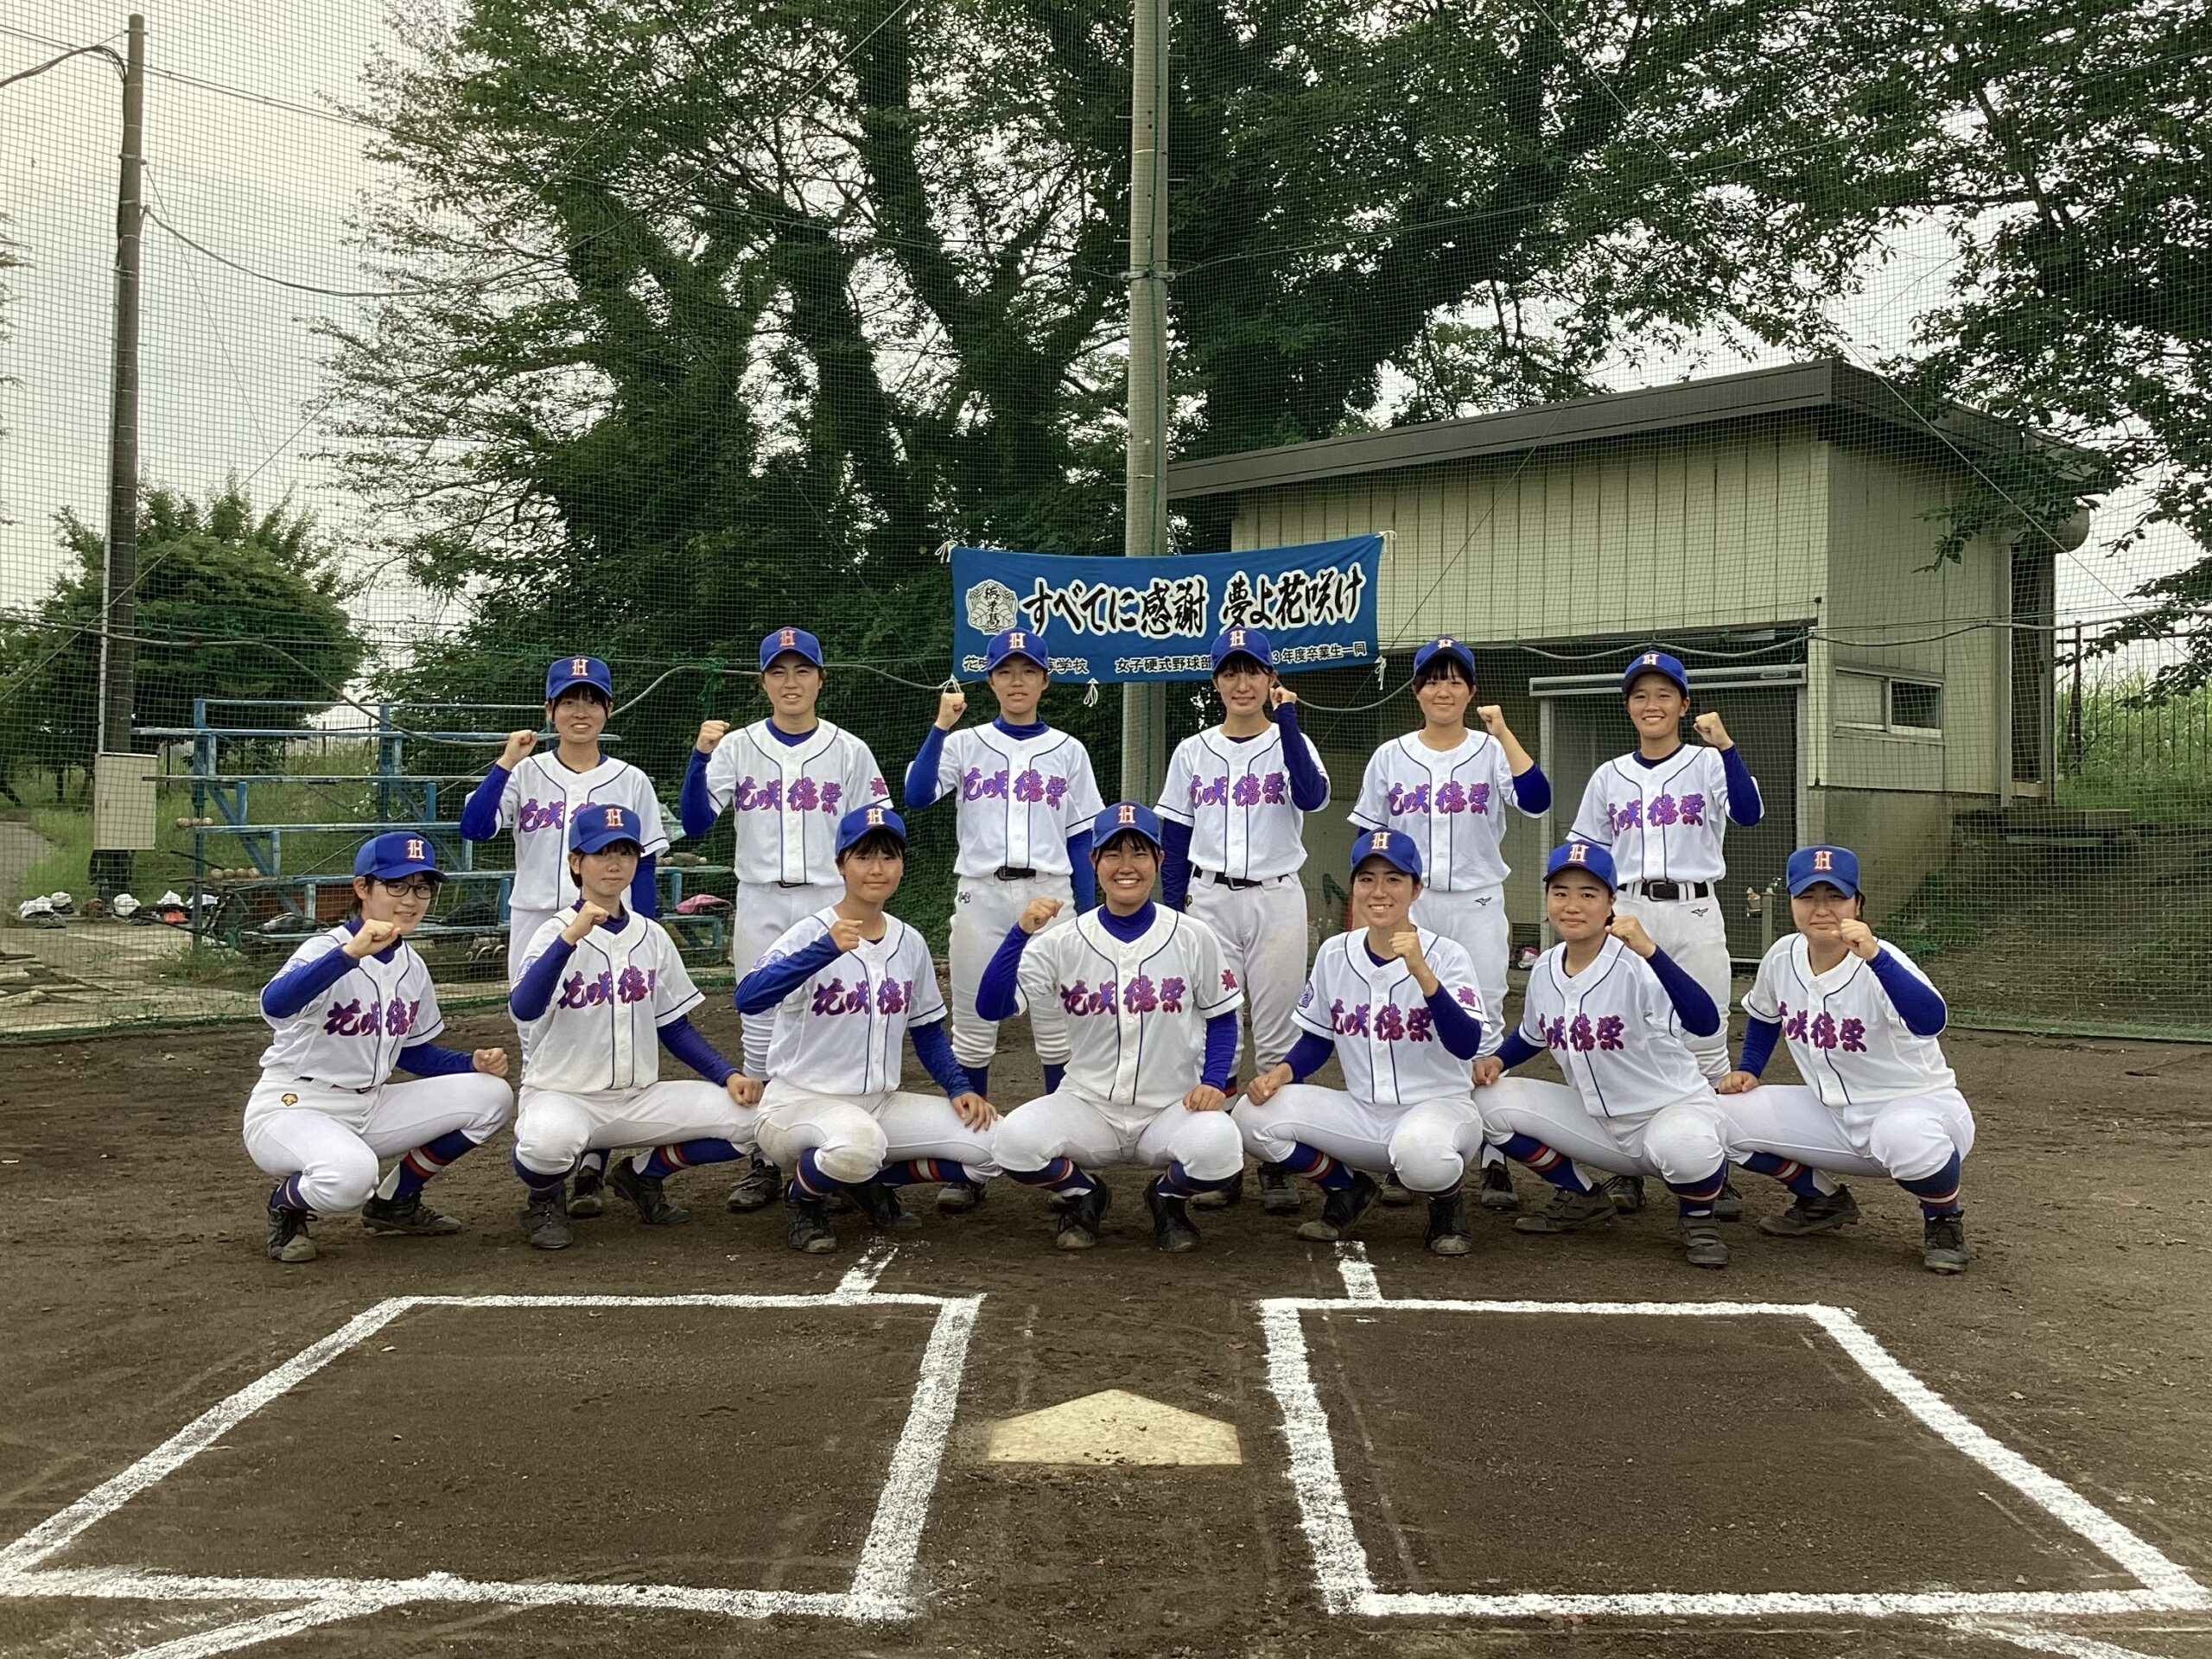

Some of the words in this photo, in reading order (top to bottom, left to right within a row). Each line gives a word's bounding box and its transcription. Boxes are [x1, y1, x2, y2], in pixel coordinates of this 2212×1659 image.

[1020, 576, 1207, 636] すべてに感謝
[1220, 564, 1364, 632] 夢よ花咲け
[779, 629, 797, 647] H
[1008, 632, 1027, 650] H
[1229, 629, 1247, 648] H
[571, 658, 589, 677] H
[1641, 653, 1660, 666] H
[605, 808, 625, 828] H
[866, 808, 886, 825] H
[1117, 804, 1136, 825] H
[406, 838, 425, 861] H
[1370, 831, 1391, 850] H
[1567, 843, 1591, 862] H
[1814, 849, 1834, 871] H
